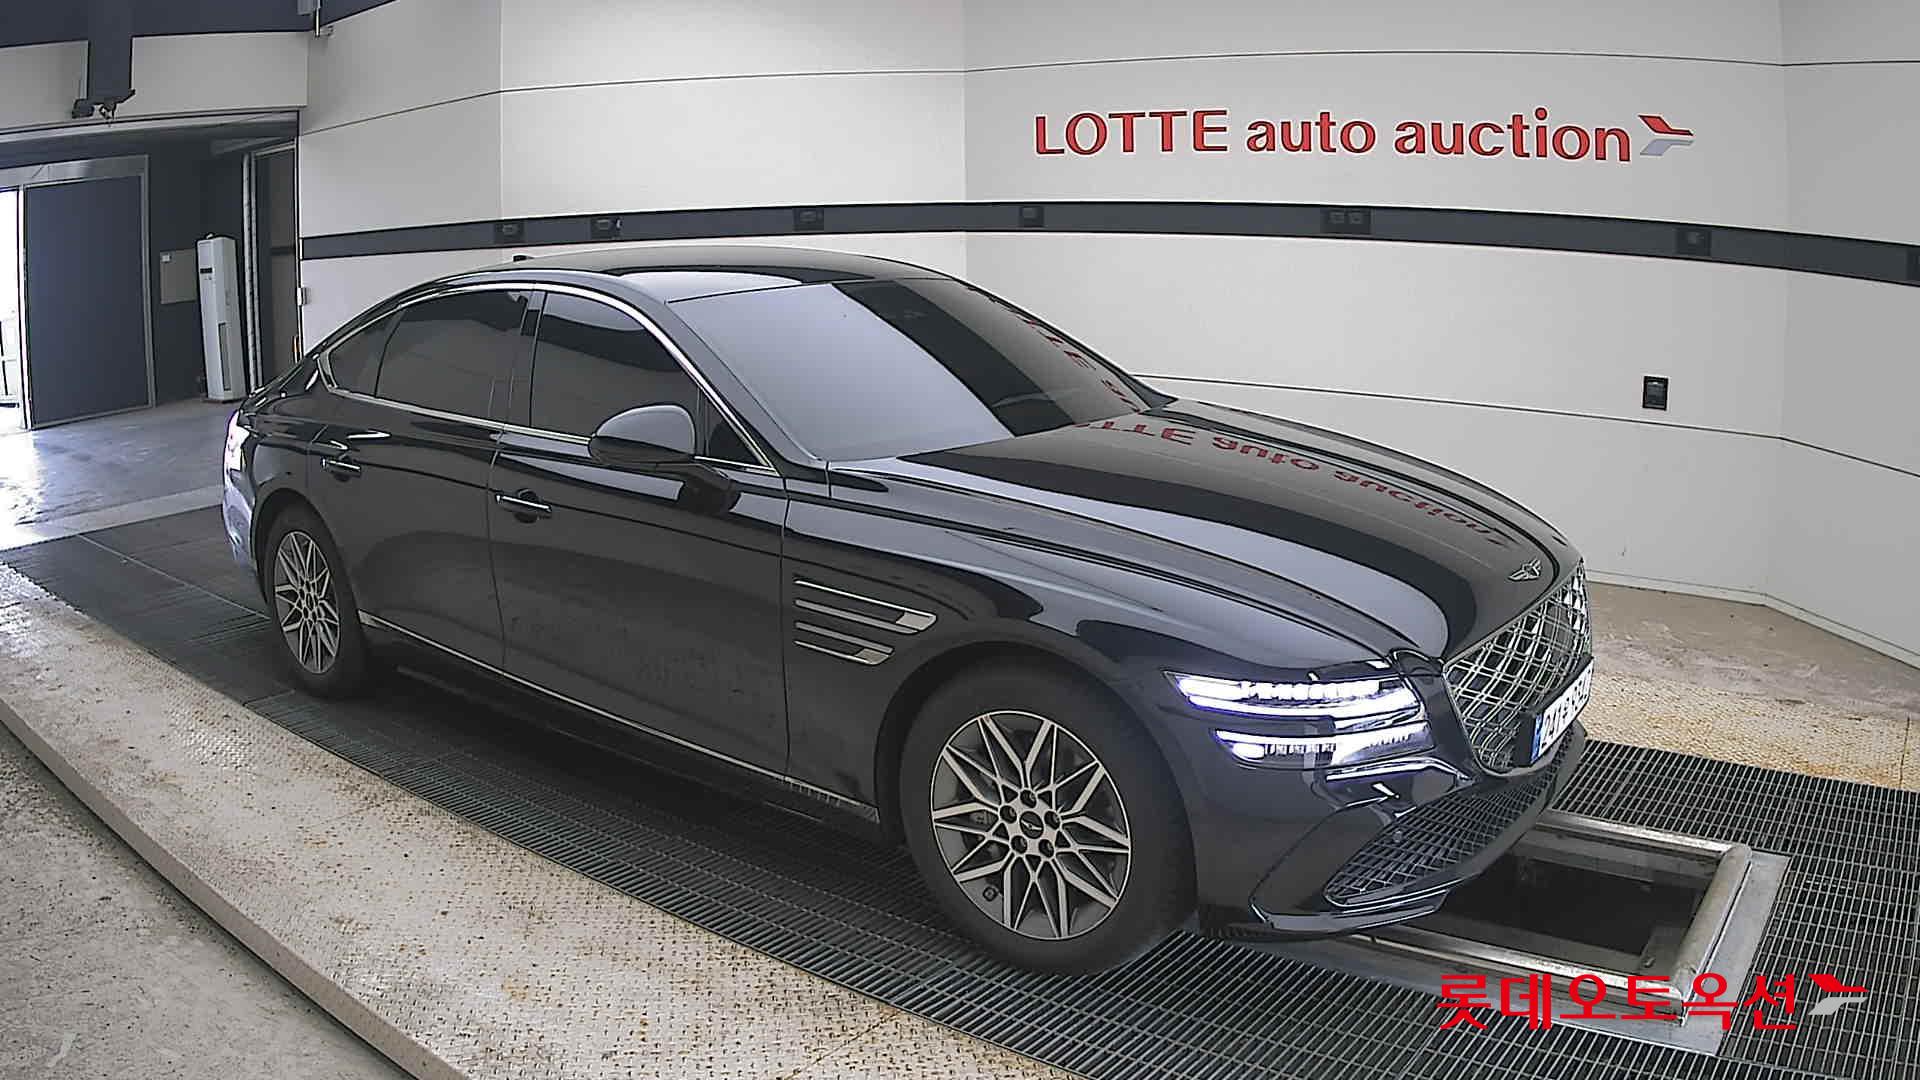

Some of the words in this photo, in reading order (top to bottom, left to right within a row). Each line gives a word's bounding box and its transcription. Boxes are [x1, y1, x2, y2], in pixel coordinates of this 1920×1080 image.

[1035, 109, 1229, 155] LOTTE
[1246, 111, 1376, 155] auto
[1394, 107, 1631, 162] auction
